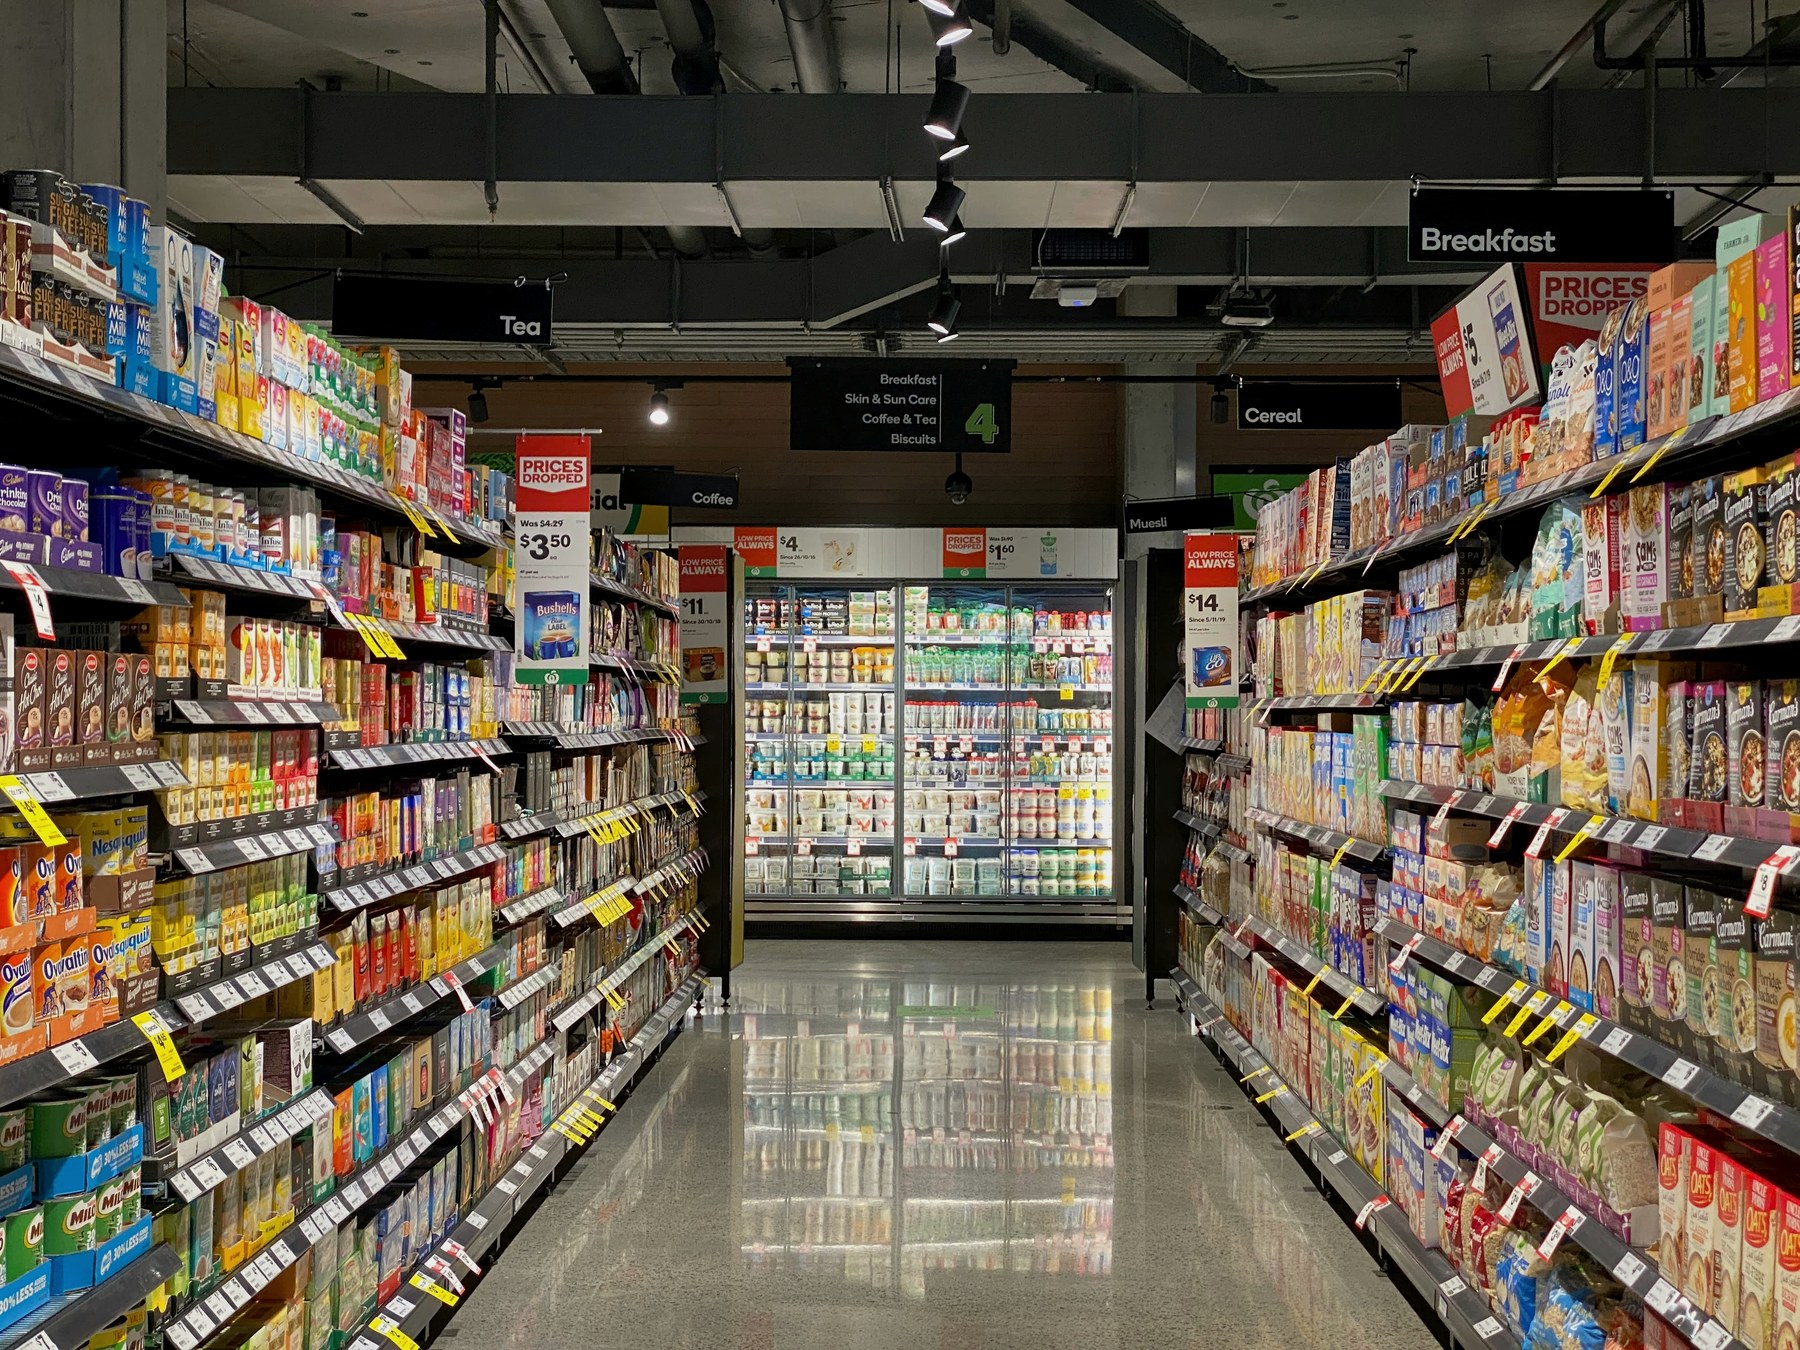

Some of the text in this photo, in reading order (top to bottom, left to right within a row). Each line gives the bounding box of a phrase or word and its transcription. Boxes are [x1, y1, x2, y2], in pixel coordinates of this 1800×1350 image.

[1421, 227, 1556, 252] Breakfast
[1545, 276, 1648, 298] PRICES
[1545, 299, 1631, 316] DROPP
[499, 315, 541, 336] Tea
[880, 373, 937, 389] Breakfast
[845, 393, 937, 405] Skin & Sun Care
[862, 413, 937, 425] Coffee & Tea
[1245, 406, 1302, 424] Cereal
[965, 403, 999, 445] 4
[891, 433, 937, 445] Biscuits
[522, 460, 583, 473] PRICES
[522, 473, 583, 484] DROPPED
[692, 491, 734, 506] Coffee
[520, 519, 538, 528] Was
[1129, 516, 1168, 531] Muesli
[737, 541, 774, 550] ALWAYS
[779, 535, 799, 552] $4
[947, 536, 982, 544] PRICES
[700, 558, 724, 566] PRICE
[1188, 551, 1235, 559] LOW PRICE
[680, 565, 725, 575] ALWAYS
[1187, 558, 1236, 569] ALWAYS
[536, 601, 577, 616] Bushells
[682, 598, 703, 615] $11
[1188, 593, 1218, 612] $14
[547, 623, 567, 631] LABEL
[1660, 1154, 1677, 1179] OATS
[1690, 1170, 1712, 1196] OATS
[1719, 1187, 1738, 1214] OATS
[1746, 1206, 1768, 1233] OATS
[125, 1235, 140, 1253] LESS
[15, 1281, 35, 1303] LESS
